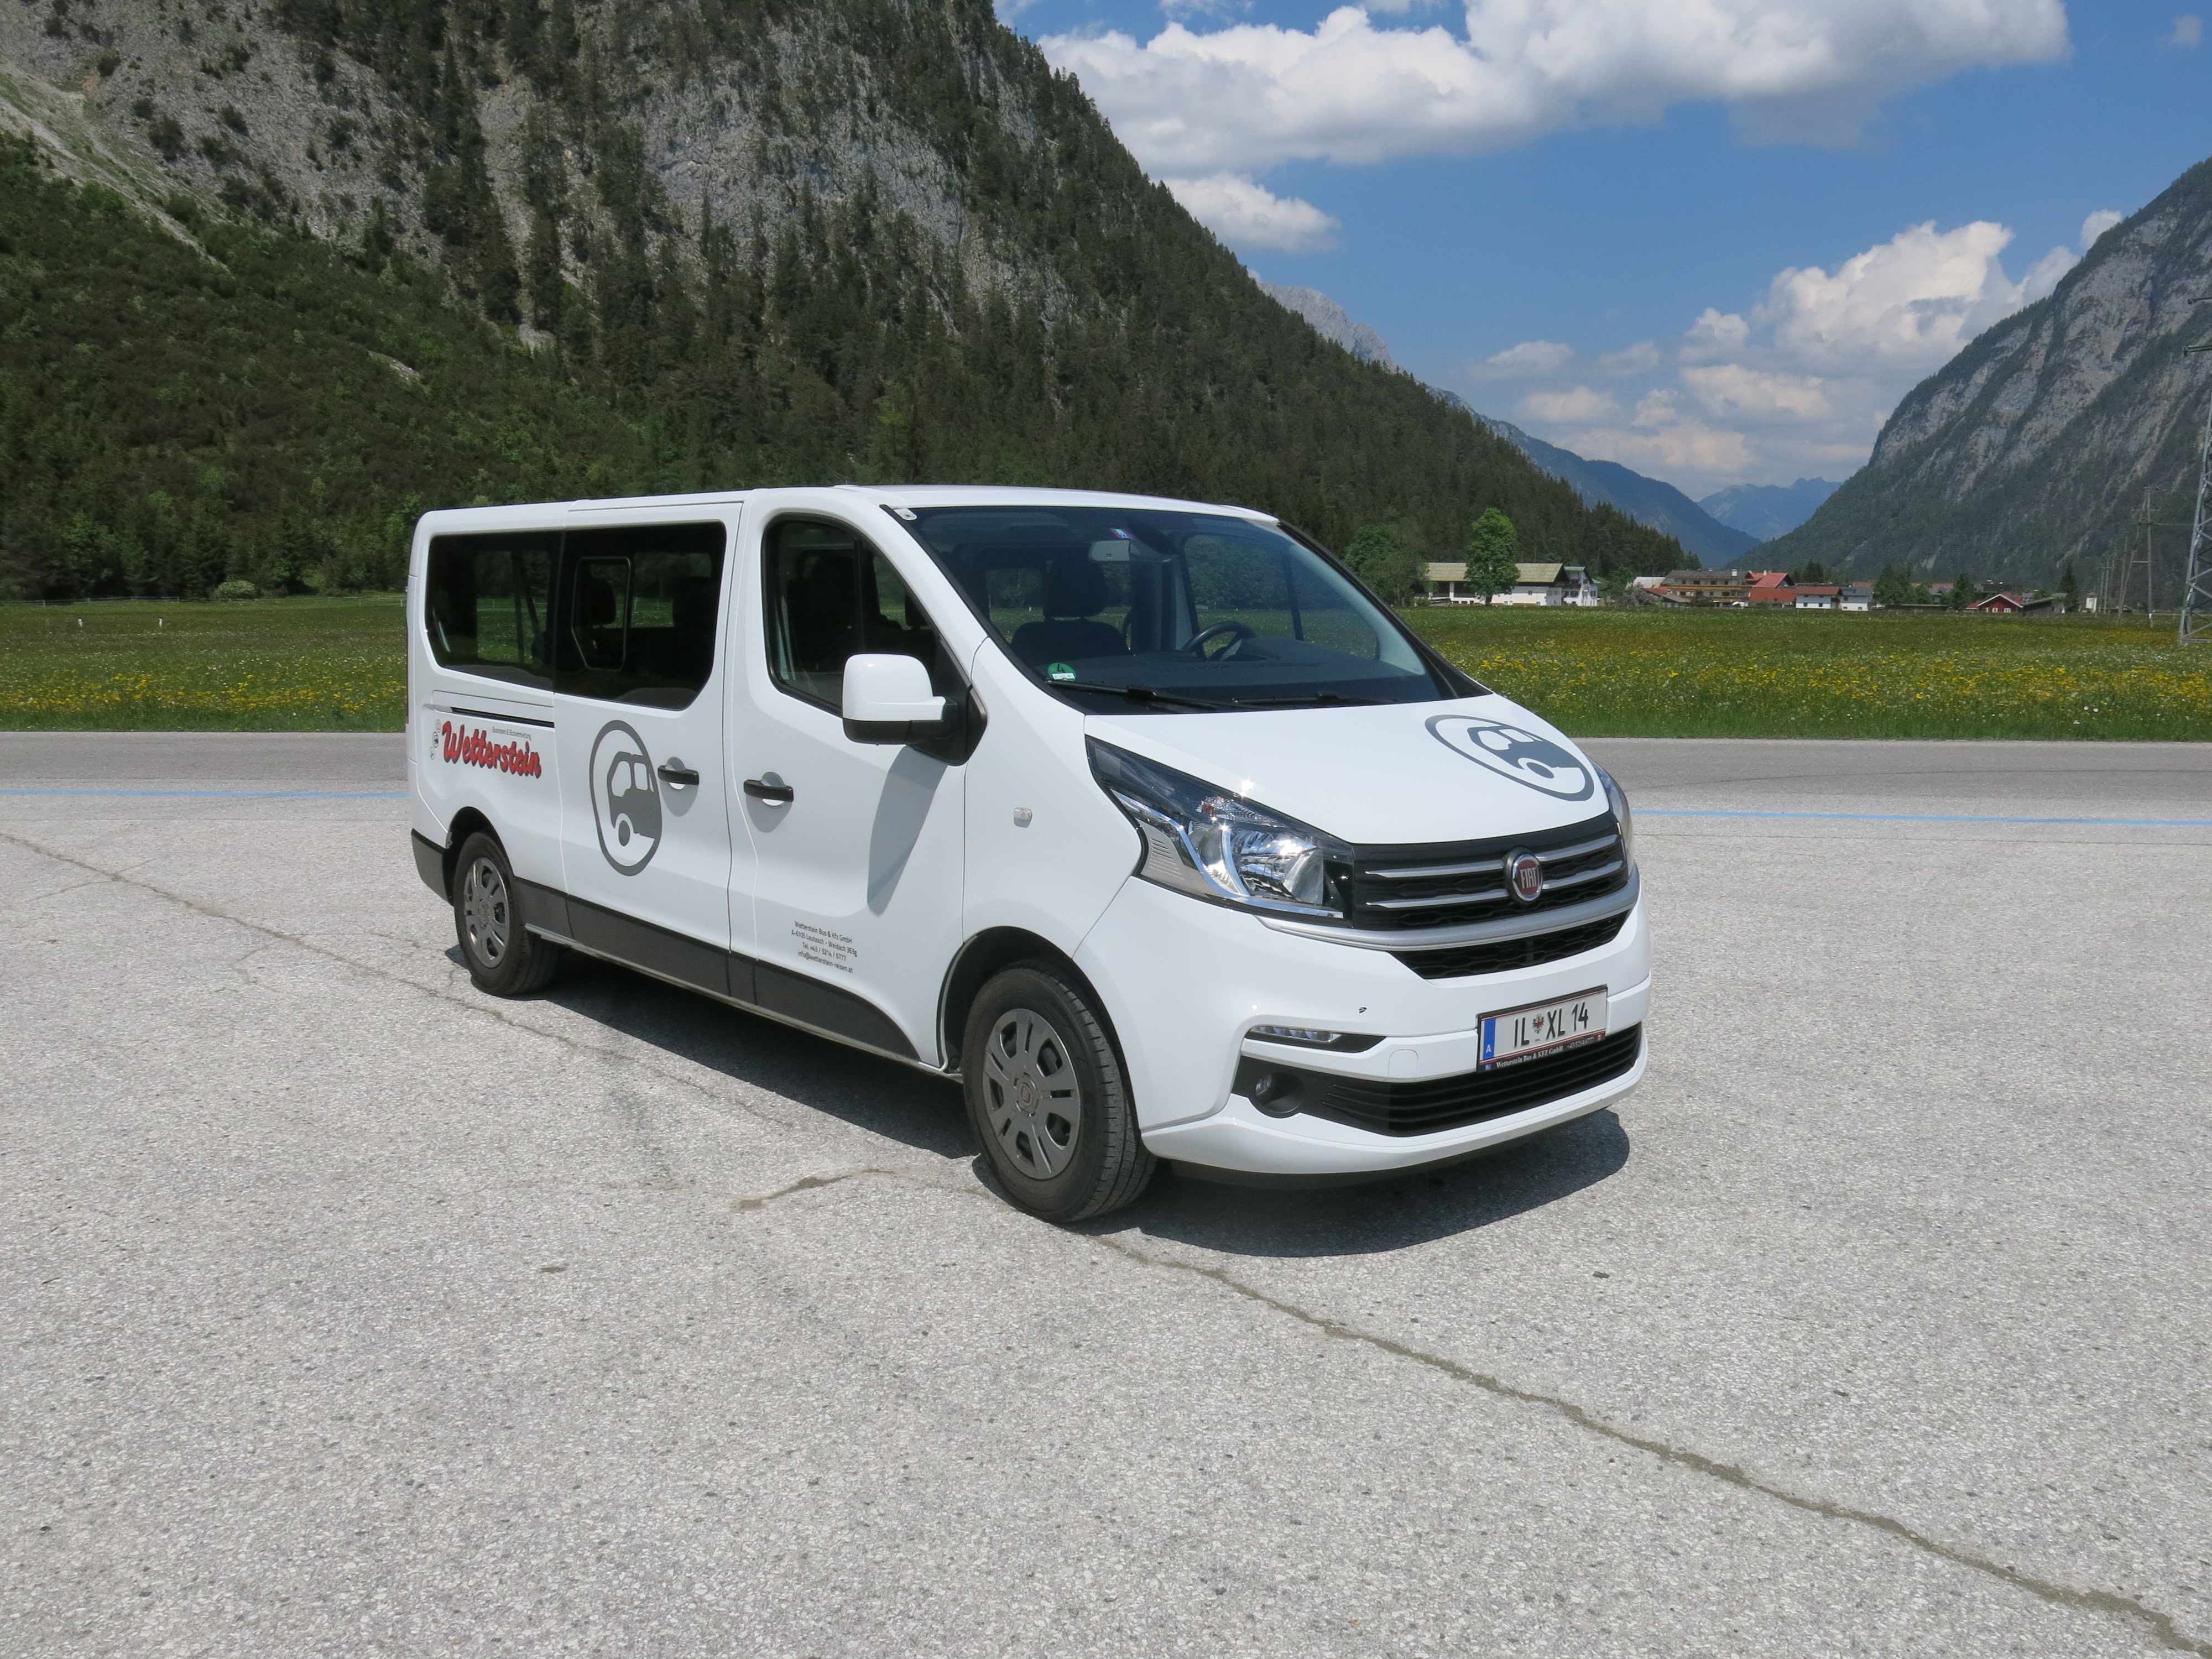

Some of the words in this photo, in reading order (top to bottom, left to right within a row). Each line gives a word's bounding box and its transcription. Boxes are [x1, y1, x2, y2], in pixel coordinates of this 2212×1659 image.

[1057, 664, 1066, 673] 4
[442, 721, 542, 779] Wetterstein
[1520, 867, 1537, 889] FIAT
[794, 920, 818, 933] Wetterstein
[818, 928, 827, 936] Bus
[839, 935, 853, 944] GmbH
[806, 933, 825, 945] Leutasch
[828, 941, 846, 952] Weidach
[822, 948, 832, 957] 5214
[1514, 1016, 1530, 1048] IL
[1546, 1008, 1566, 1040] XL
[1571, 1001, 1589, 1031] 14
[1485, 1044, 1492, 1053] A
[1496, 1056, 1522, 1068] Wetterstein
[1548, 1045, 1564, 1055] GmbH
